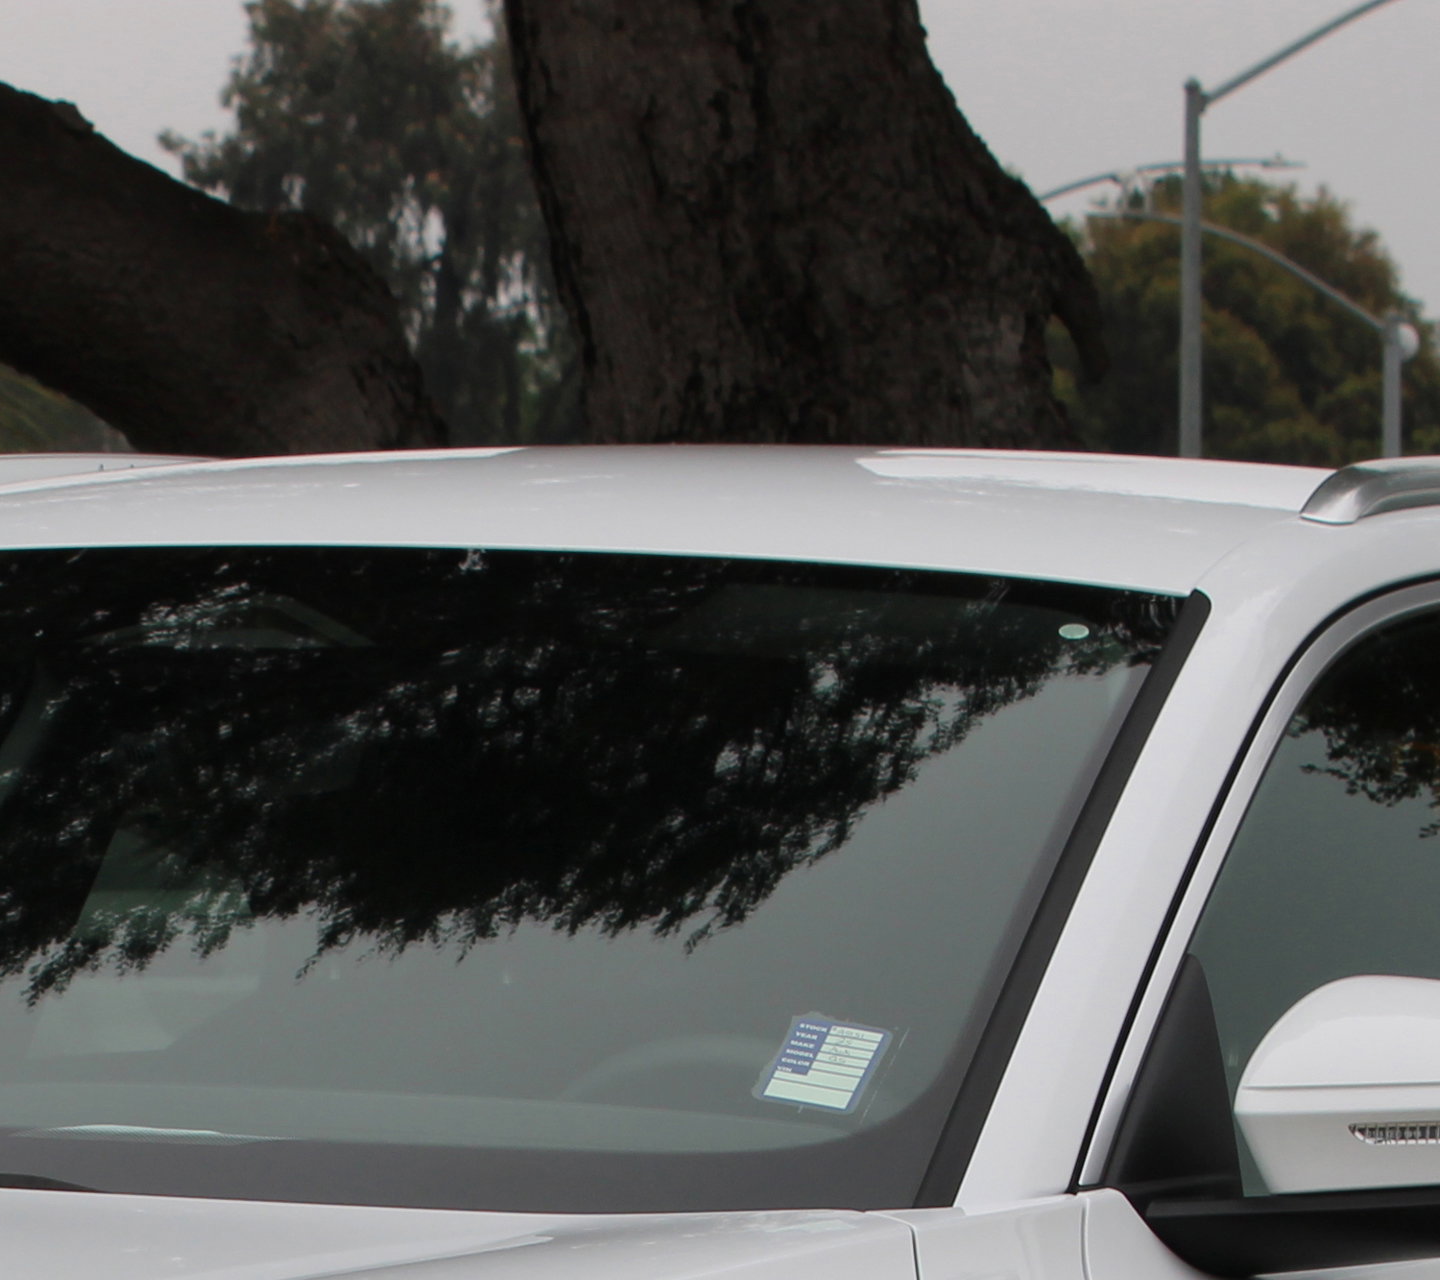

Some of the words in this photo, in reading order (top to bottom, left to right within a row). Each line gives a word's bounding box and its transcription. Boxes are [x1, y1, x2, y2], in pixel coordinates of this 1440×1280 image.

[800, 1023, 827, 1032] STOCK
[795, 1031, 818, 1040] YEAR
[790, 1040, 815, 1048] MAKE
[786, 1048, 813, 1058] MODEL
[781, 1057, 810, 1066] COLOR
